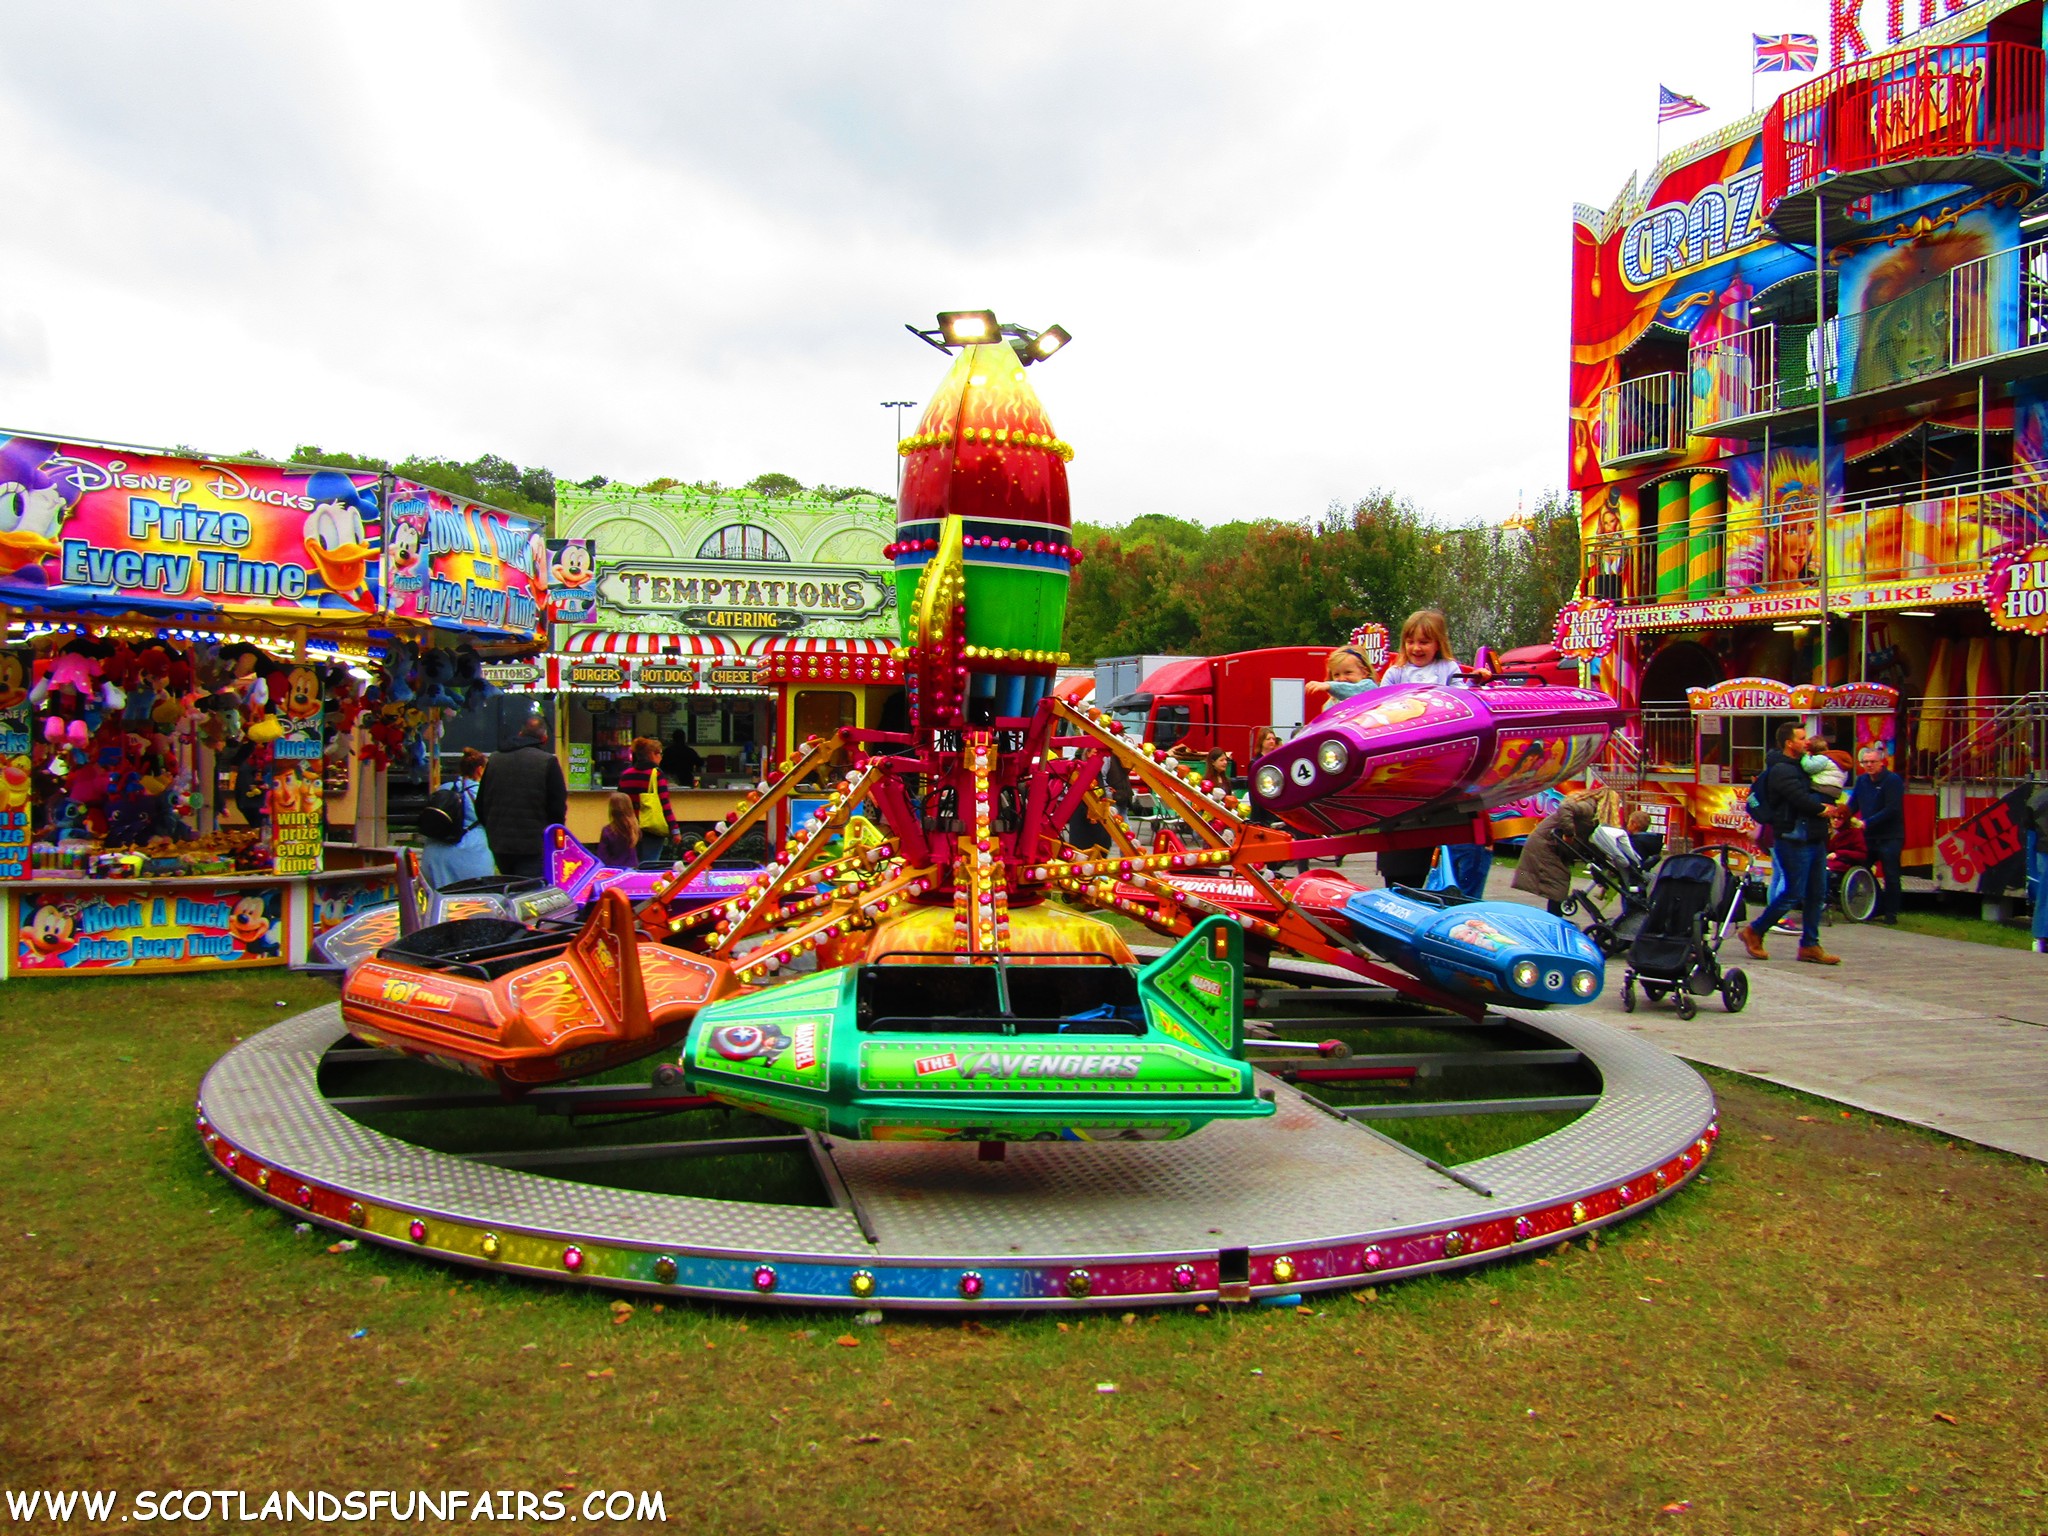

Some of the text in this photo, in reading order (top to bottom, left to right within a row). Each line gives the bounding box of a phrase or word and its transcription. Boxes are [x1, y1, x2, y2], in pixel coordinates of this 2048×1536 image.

[392, 501, 426, 518] Quality
[129, 497, 251, 547] Prize
[61, 539, 306, 599] Every Time
[2006, 560, 2048, 591] FU
[619, 571, 865, 611] TEMPTATIONS
[1702, 605, 1733, 618] NO
[1867, 585, 1932, 603] LIKE
[1952, 581, 1984, 596] SH
[464, 577, 506, 627] Every
[507, 586, 537, 631] Time
[706, 611, 778, 628] CATERING
[1563, 607, 1608, 624] CRAZY
[1569, 621, 1603, 636] KING
[1562, 634, 1607, 650] CIRCUS
[1366, 649, 1385, 665] USE
[482, 667, 533, 680] PTATIONS
[572, 668, 621, 681] BURGERS
[640, 669, 693, 683] HOT DOGS
[712, 670, 750, 683] CHEESE
[1709, 690, 1790, 709] PAY HERE
[1297, 763, 1312, 780] 4
[278, 813, 306, 825] win
[279, 827, 320, 843] prize
[1938, 803, 2012, 865] EXIT
[276, 843, 322, 858] every
[1952, 825, 2021, 883] ONLY
[280, 858, 317, 873] time
[1168, 880, 1254, 897] SPIDER-MAN
[83, 897, 231, 933] Hook A Duck
[78, 933, 233, 960] Prize Every Time
[1548, 973, 1560, 986] 3
[382, 978, 451, 1006] TOY STORY
[795, 1023, 816, 1070] MARVEL
[920, 1052, 1143, 1080] THE AVENGERS
